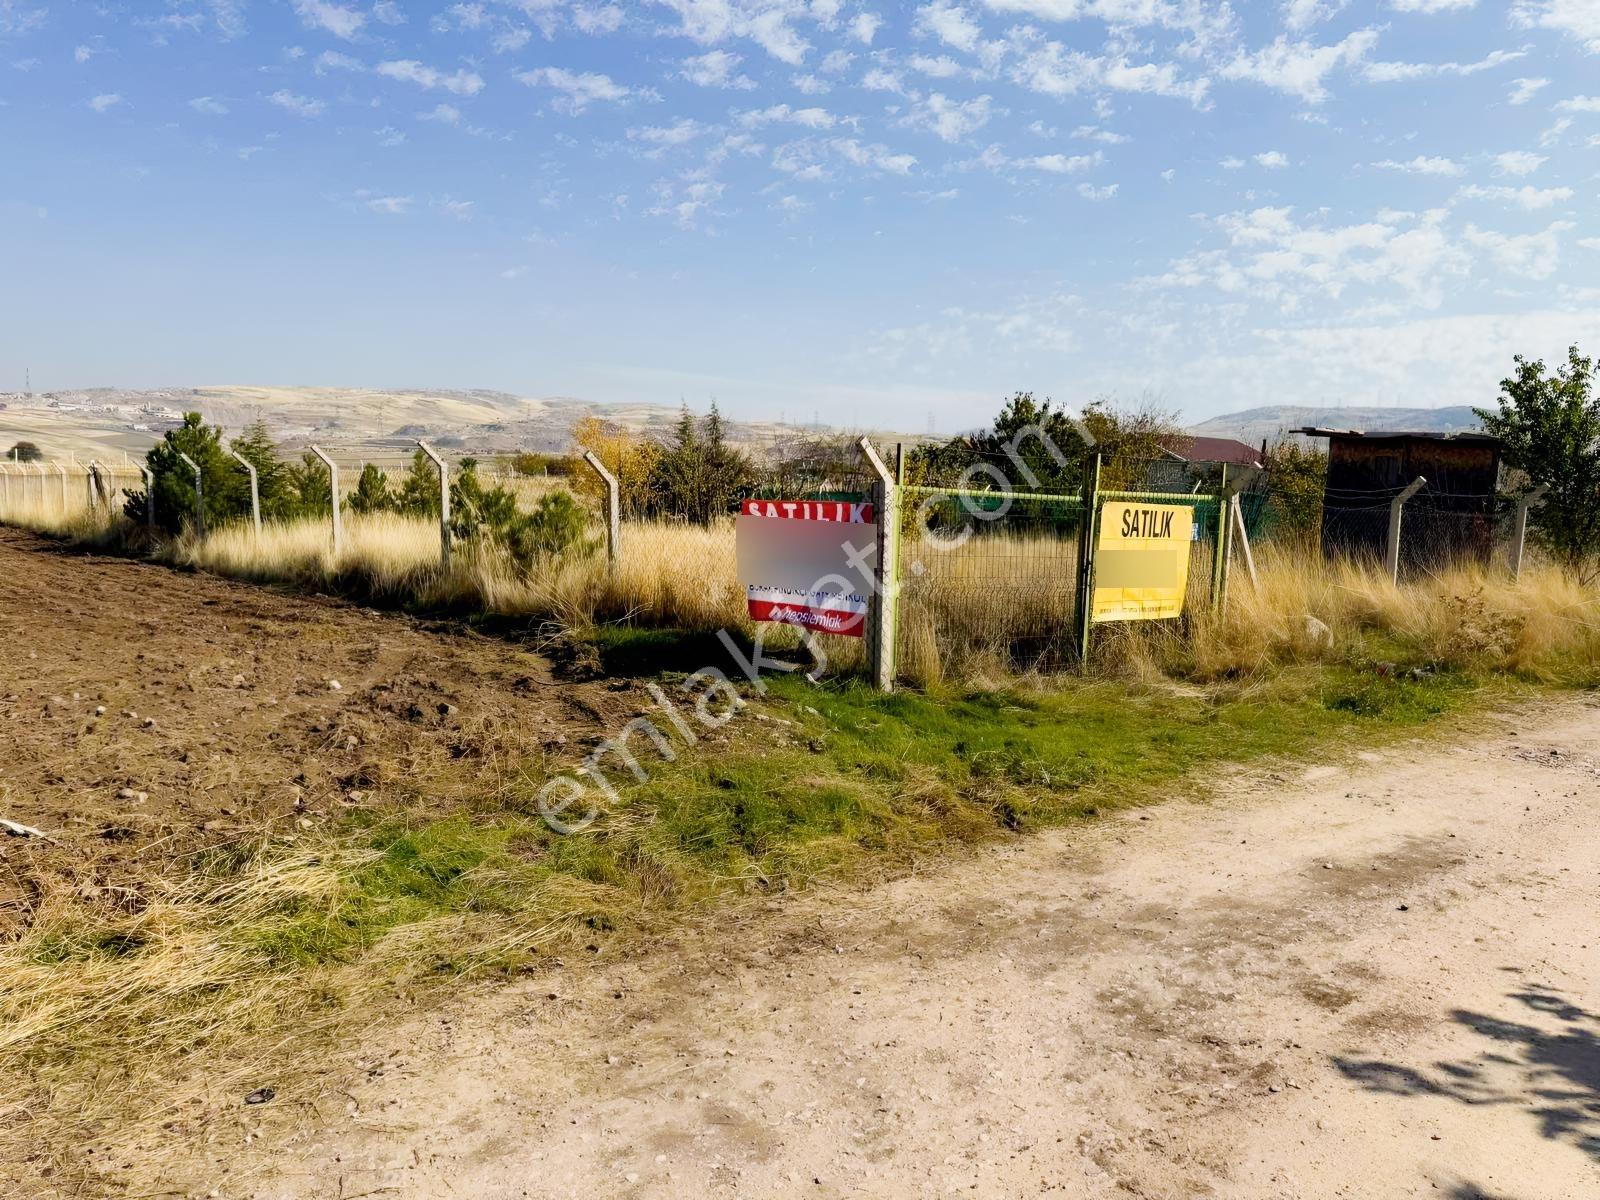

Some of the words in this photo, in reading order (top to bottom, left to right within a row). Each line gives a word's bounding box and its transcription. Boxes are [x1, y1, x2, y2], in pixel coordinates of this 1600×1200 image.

[748, 502, 865, 523] SATILIK
[1121, 508, 1175, 538] SATILIK
[783, 606, 842, 629] hepsiemlak
